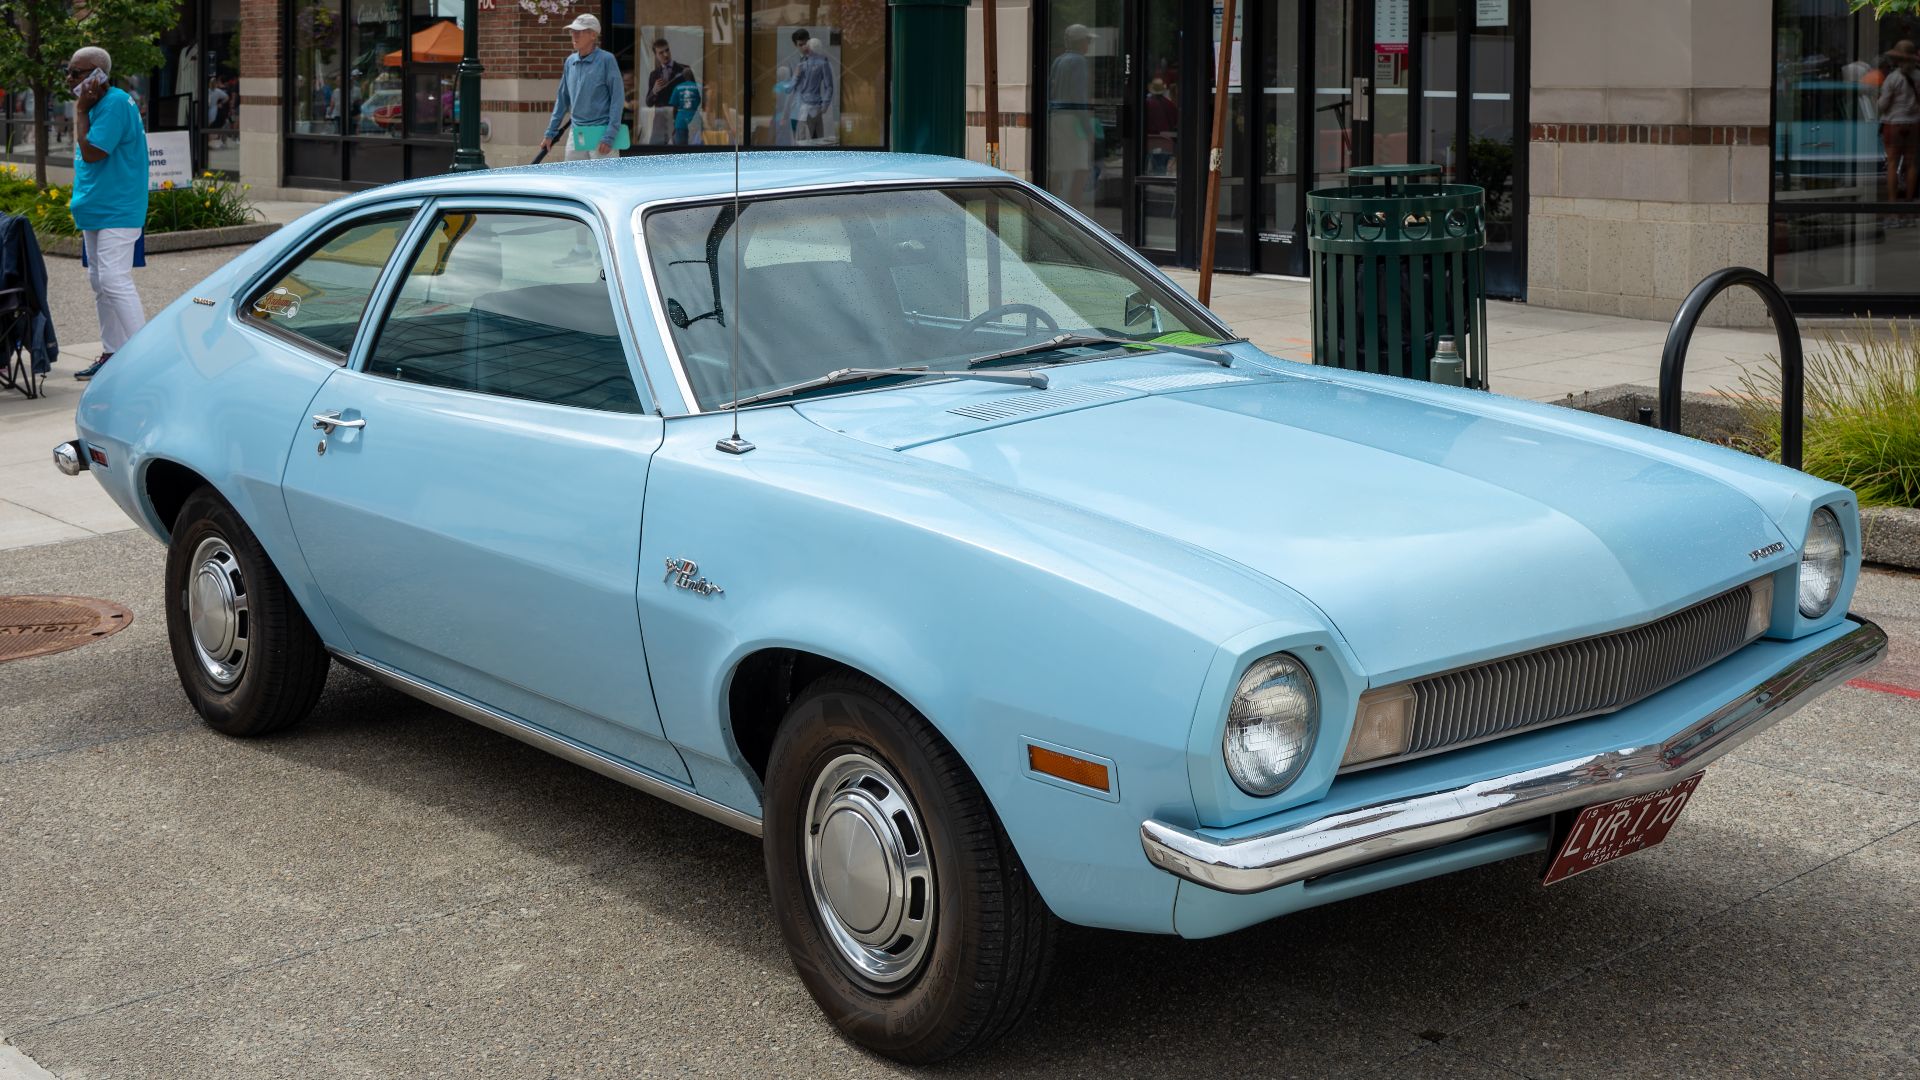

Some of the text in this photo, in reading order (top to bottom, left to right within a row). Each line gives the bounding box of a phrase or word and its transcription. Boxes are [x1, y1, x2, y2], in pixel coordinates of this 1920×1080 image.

[672, 557, 724, 596] Pinto
[1586, 779, 1696, 819] 19 MICHIGAN 71
[1583, 834, 1644, 860] GREAT LAKE
[1592, 848, 1623, 865] STATE
